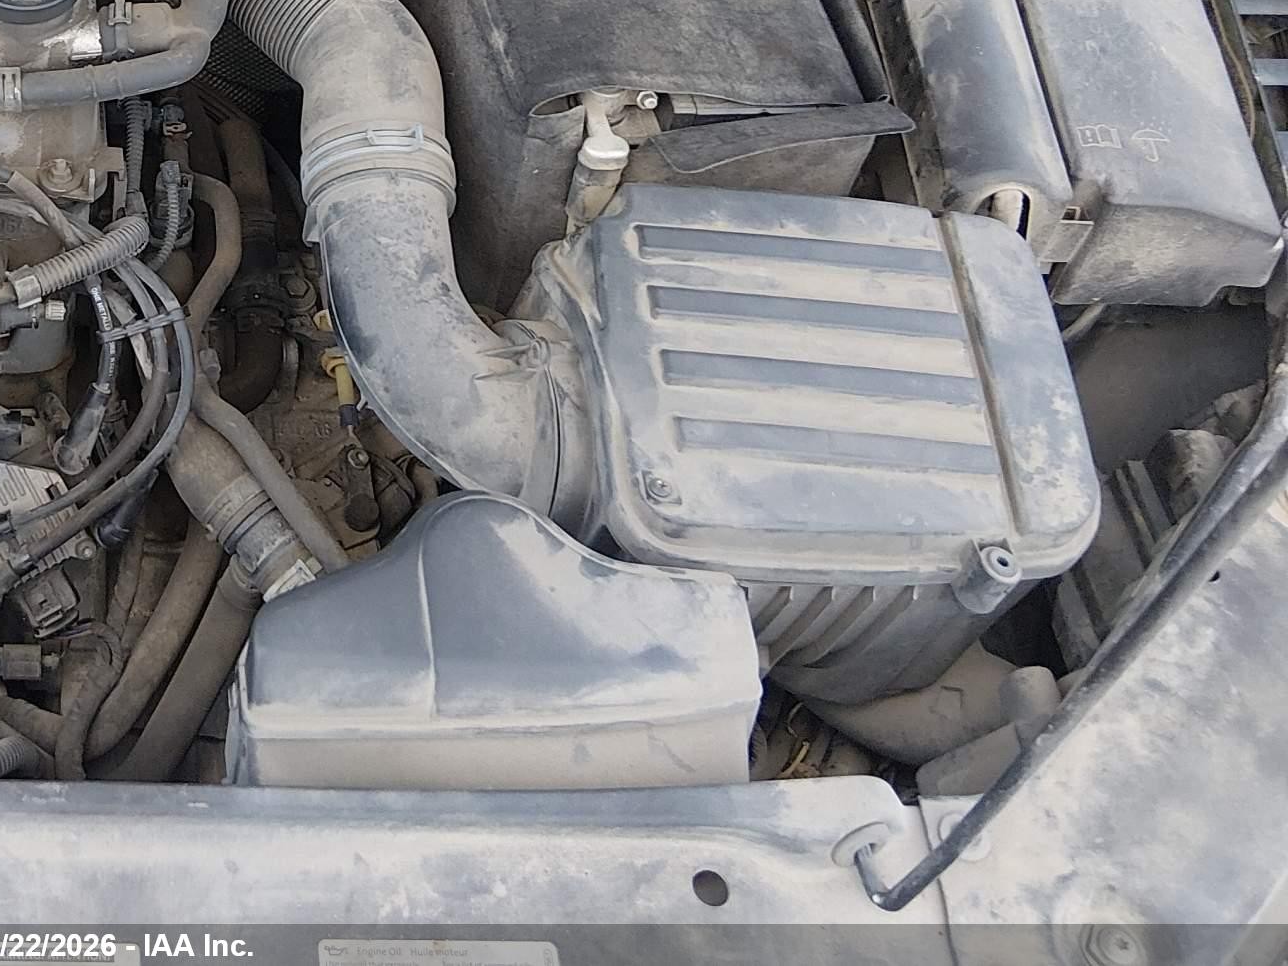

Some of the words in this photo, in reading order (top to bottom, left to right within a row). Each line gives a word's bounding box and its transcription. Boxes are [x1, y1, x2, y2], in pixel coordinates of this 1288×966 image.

[356, 946, 386, 958] Engine
[389, 946, 401, 955] Oil
[410, 947, 434, 956] Huile
